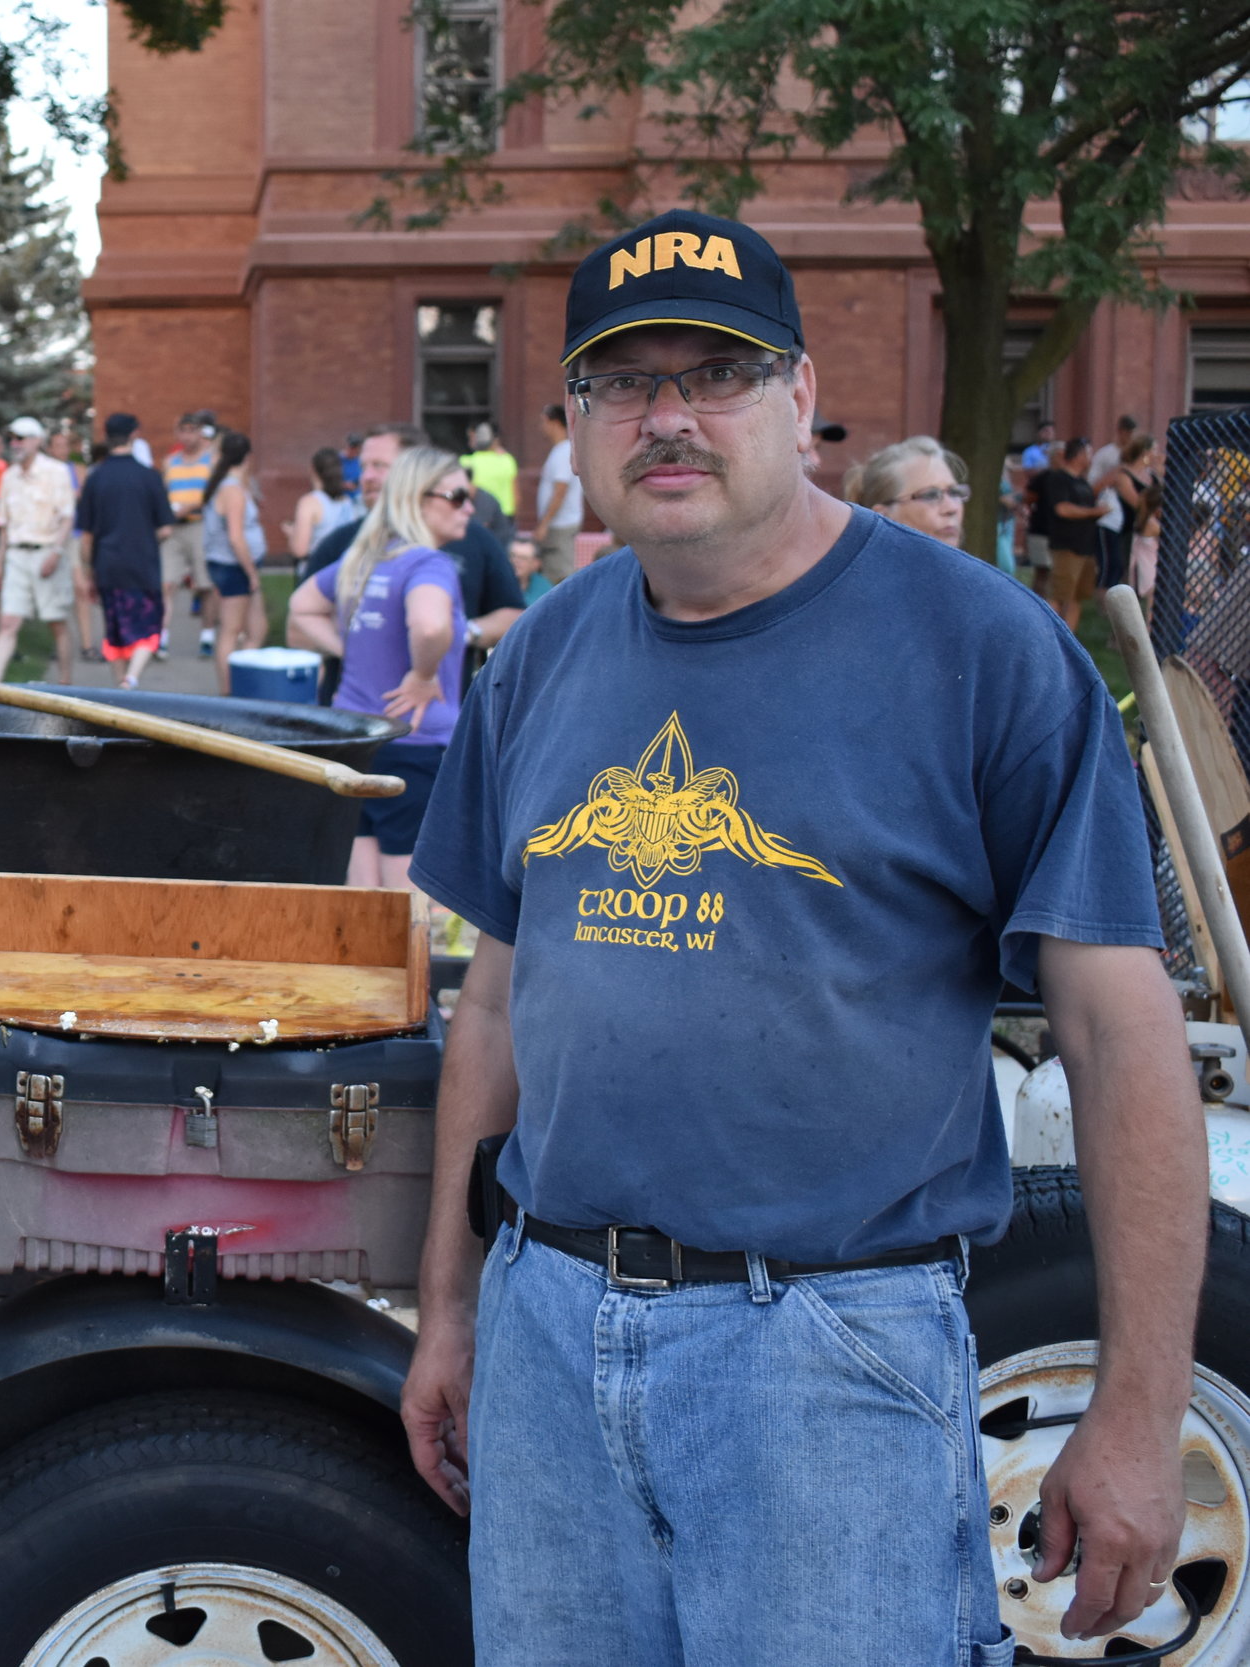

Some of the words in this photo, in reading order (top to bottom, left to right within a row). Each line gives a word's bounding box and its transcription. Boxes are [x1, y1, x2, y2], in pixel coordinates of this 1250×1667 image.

[609, 232, 742, 290] NRA
[578, 888, 688, 930] TROOP
[696, 891, 724, 924] 88
